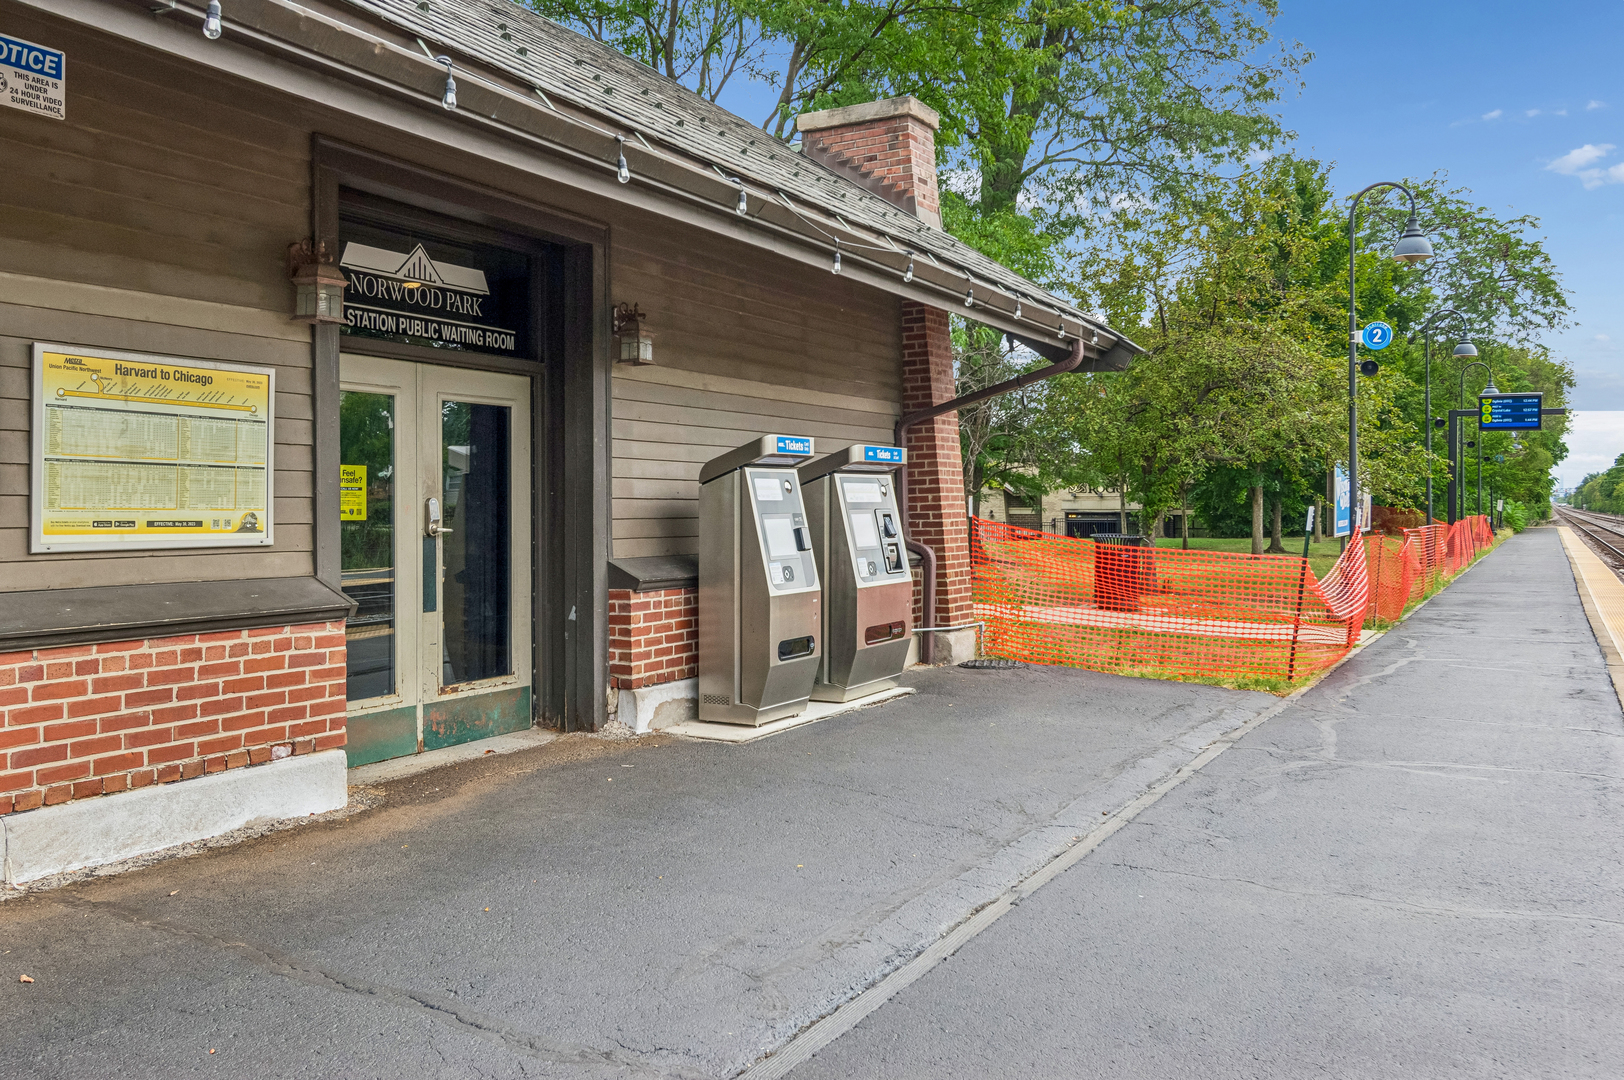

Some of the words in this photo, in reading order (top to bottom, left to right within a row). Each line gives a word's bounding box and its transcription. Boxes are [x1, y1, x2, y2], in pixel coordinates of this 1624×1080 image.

[0, 41, 58, 74] OTICE
[14, 71, 30, 81] THIS
[31, 76, 50, 88] AREA
[51, 81, 59, 90] IS
[24, 82, 48, 95] UNDER
[9, 87, 19, 95] 24
[21, 90, 41, 101] HOUR
[42, 96, 63, 107] VIDEO
[11, 95, 62, 115] SURVEILLANCE
[350, 273, 442, 309] NORWOOD
[446, 291, 483, 317] PARK
[347, 309, 396, 333] STATION
[399, 318, 439, 339] PUBLIC
[441, 324, 484, 346] WAITING
[485, 331, 515, 351] ROOM
[1373, 329, 1382, 342] 2
[63, 364, 78, 372] Pacific
[79, 366, 102, 374] Northwest
[64, 357, 83, 365] Metra
[114, 363, 158, 379] Harvard
[160, 368, 171, 381] to
[173, 369, 213, 387] Chicago
[785, 440, 803, 451] Tickets
[877, 450, 891, 459] Tickets
